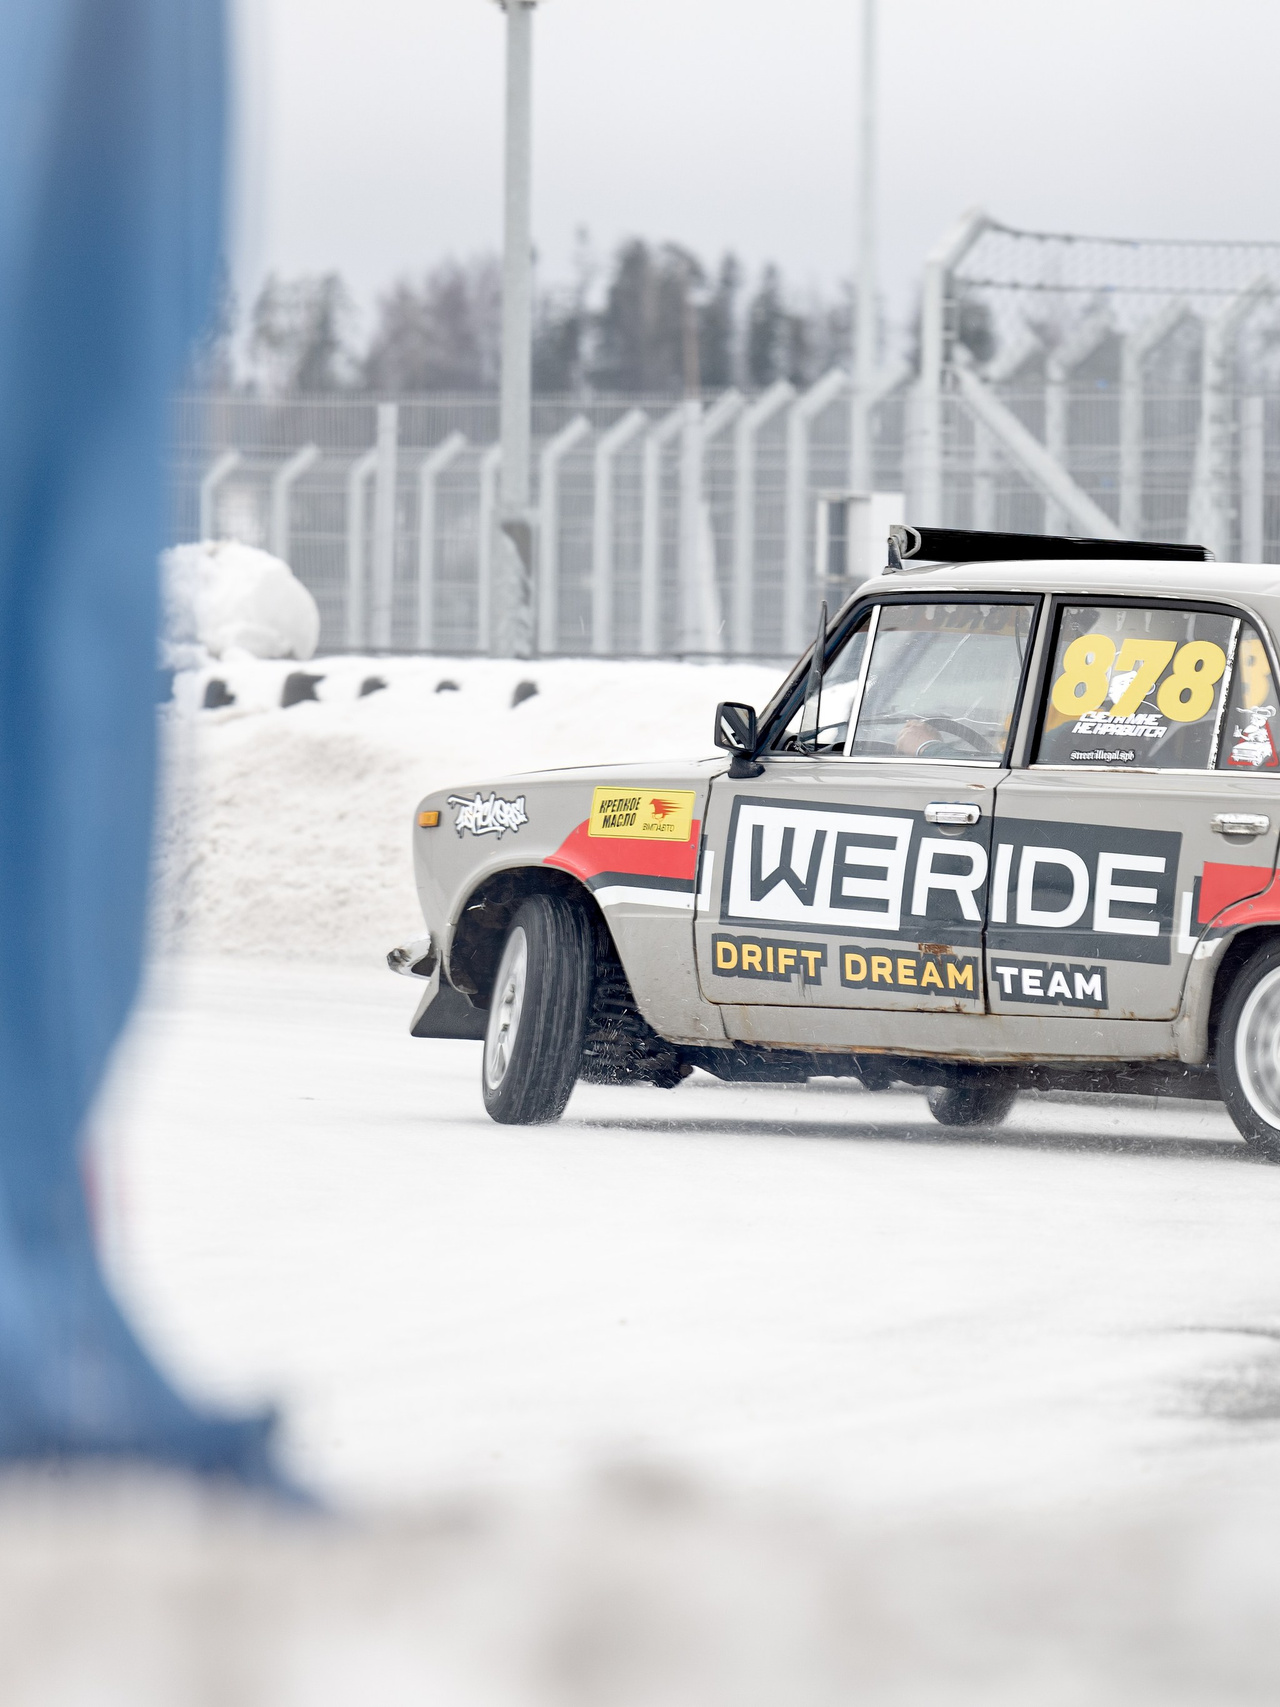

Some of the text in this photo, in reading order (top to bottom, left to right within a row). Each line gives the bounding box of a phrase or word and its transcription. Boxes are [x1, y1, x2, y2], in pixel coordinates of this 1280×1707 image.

[1052, 634, 1226, 723] 878
[599, 797, 641, 813] КРЕПКОЕ
[602, 812, 637, 828] МАСЛО
[716, 941, 1102, 1001] DRIFT DREAM TEAM
